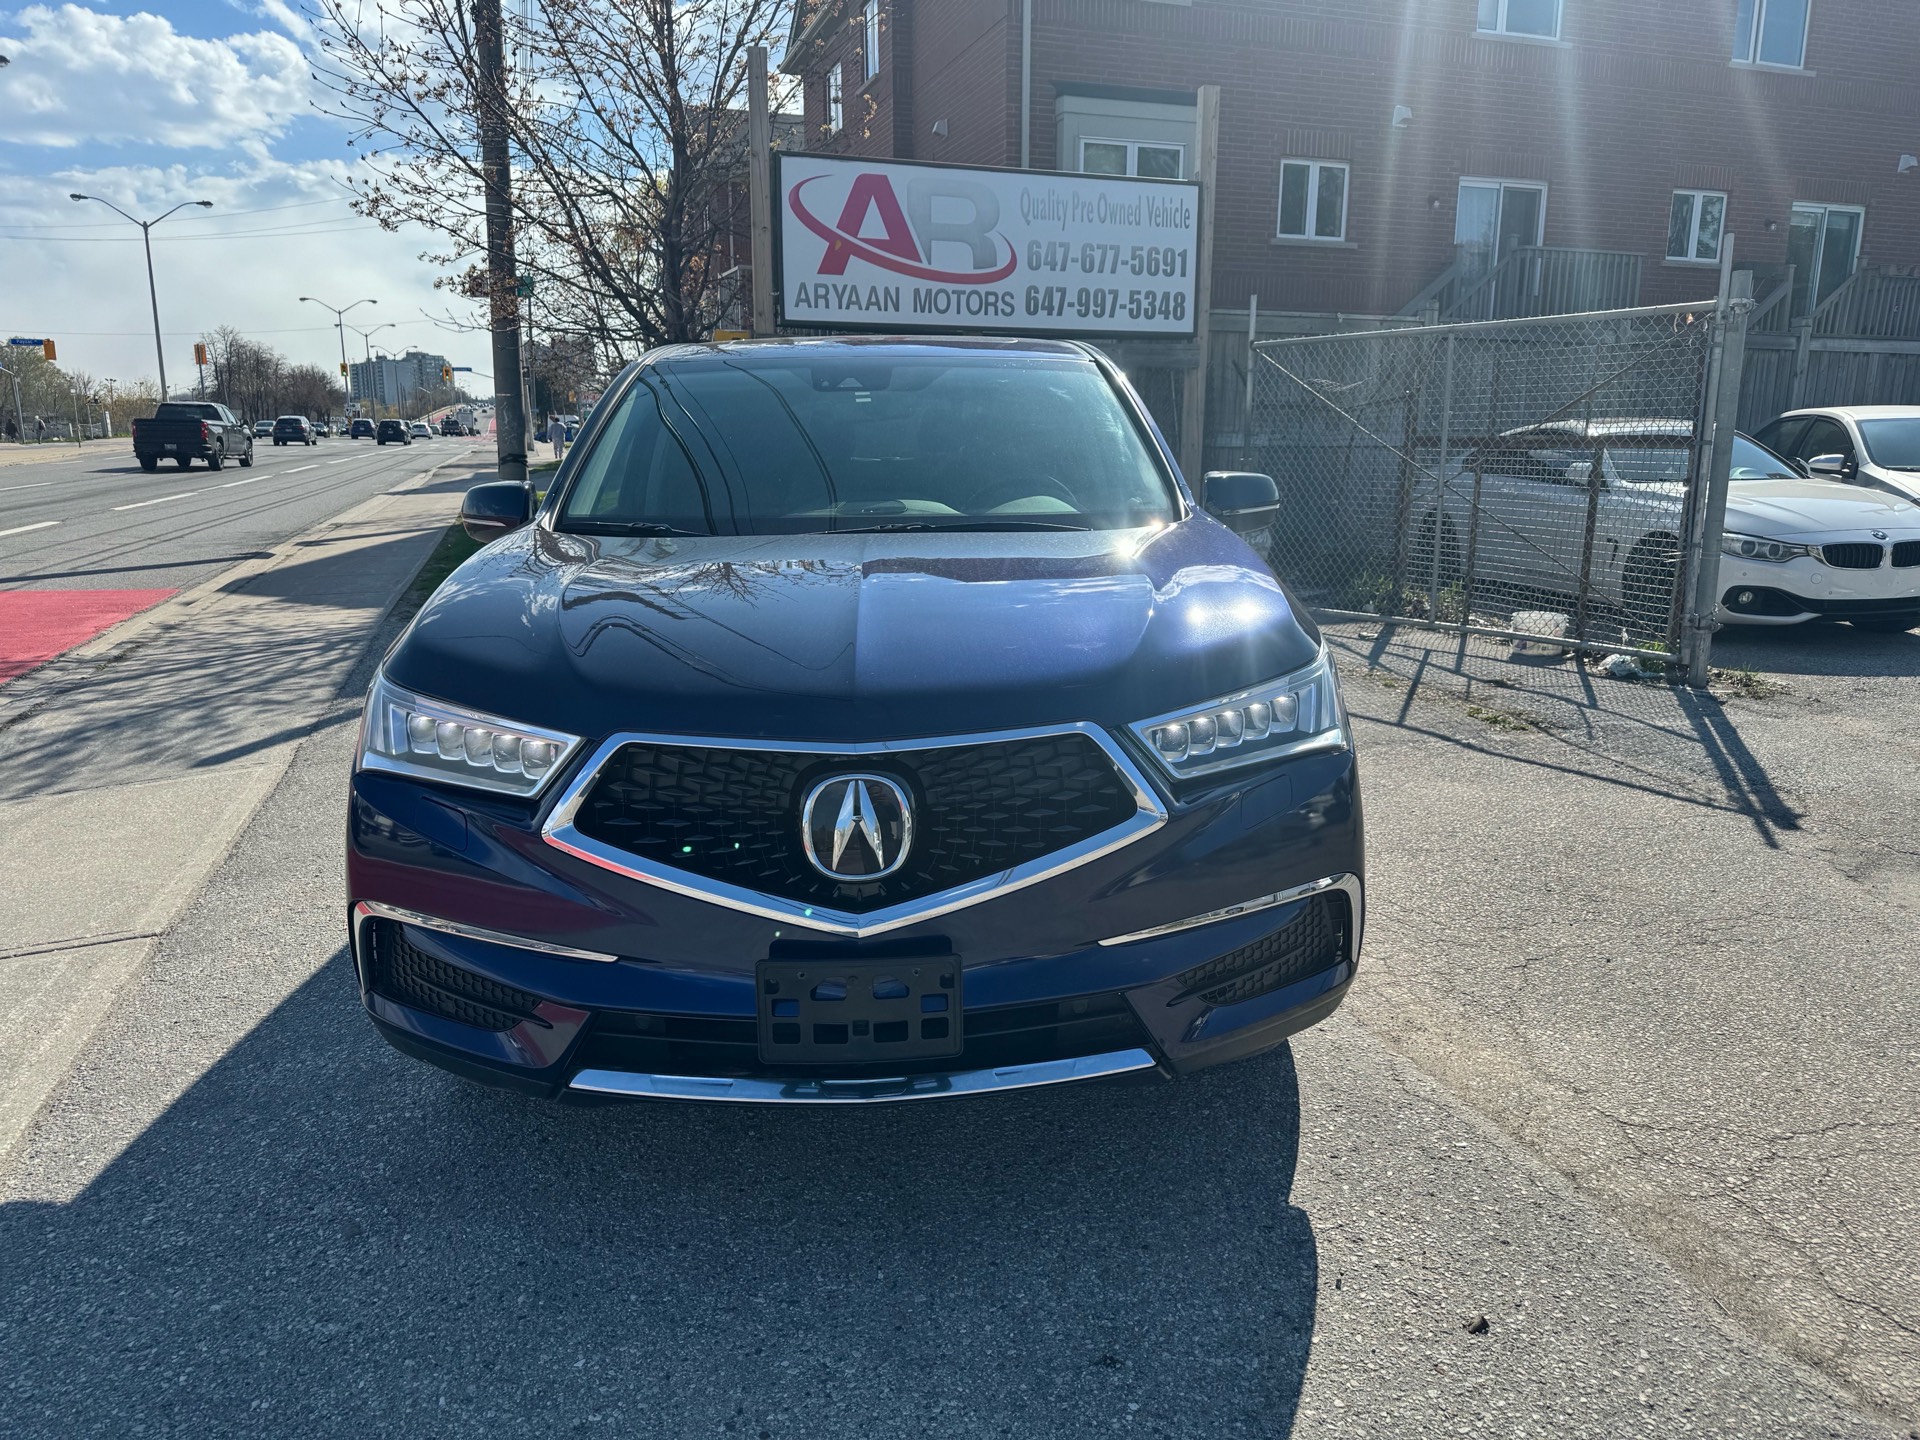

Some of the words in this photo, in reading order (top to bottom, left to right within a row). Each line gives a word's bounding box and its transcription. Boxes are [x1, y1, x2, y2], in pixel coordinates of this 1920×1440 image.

[1020, 187, 1069, 231] Quality
[1072, 190, 1094, 223] Pre
[1097, 192, 1142, 226] Owned
[1146, 195, 1191, 229] Vehicle
[1027, 239, 1188, 277] 647-677-5691
[794, 281, 900, 312] ARYAAN
[912, 287, 1016, 317] MOTORS
[1025, 285, 1187, 321] 647-997-5348
